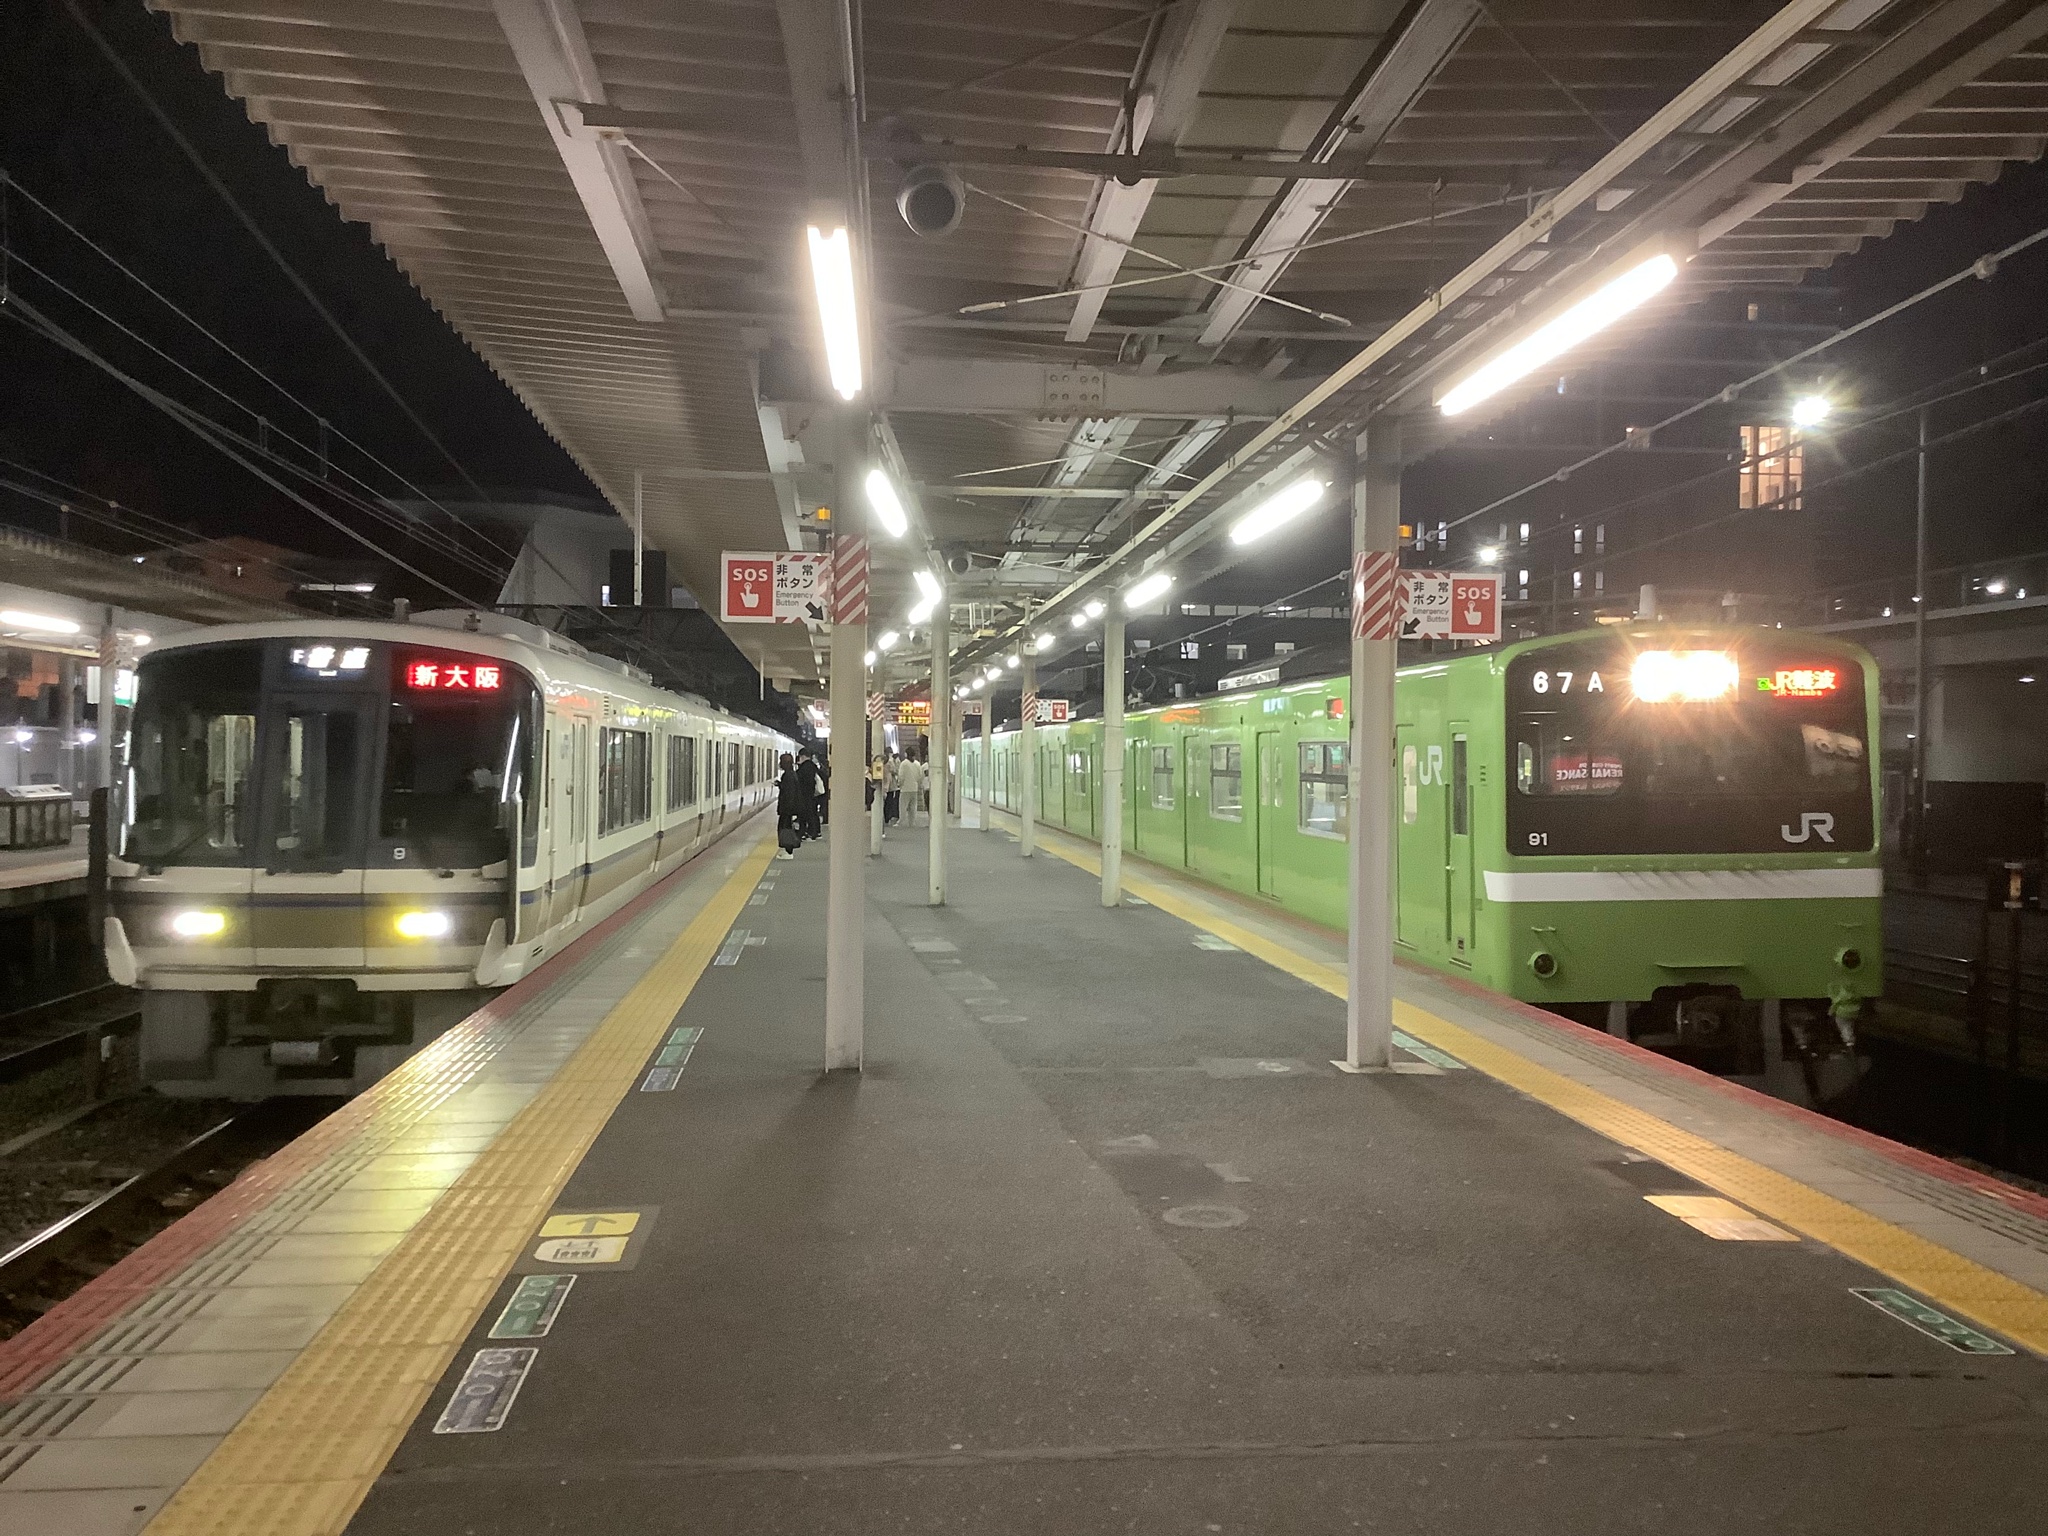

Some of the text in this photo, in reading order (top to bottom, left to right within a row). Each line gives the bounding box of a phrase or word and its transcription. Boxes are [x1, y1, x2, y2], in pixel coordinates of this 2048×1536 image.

[733, 568, 768, 582] SOS
[776, 564, 814, 576] 非常
[776, 577, 814, 589] ボタン
[1413, 581, 1449, 593] 非常
[776, 590, 814, 599] Emergency
[1413, 594, 1449, 605] ボタン
[1457, 587, 1491, 600] SOS
[1412, 607, 1450, 616] Emergency
[1426, 615, 1450, 623] Button
[414, 665, 500, 688] 新大阪
[1419, 745, 1443, 786] JR
[1781, 812, 1835, 844] JR
[1528, 832, 1548, 846] 91
[393, 847, 406, 860] 9
